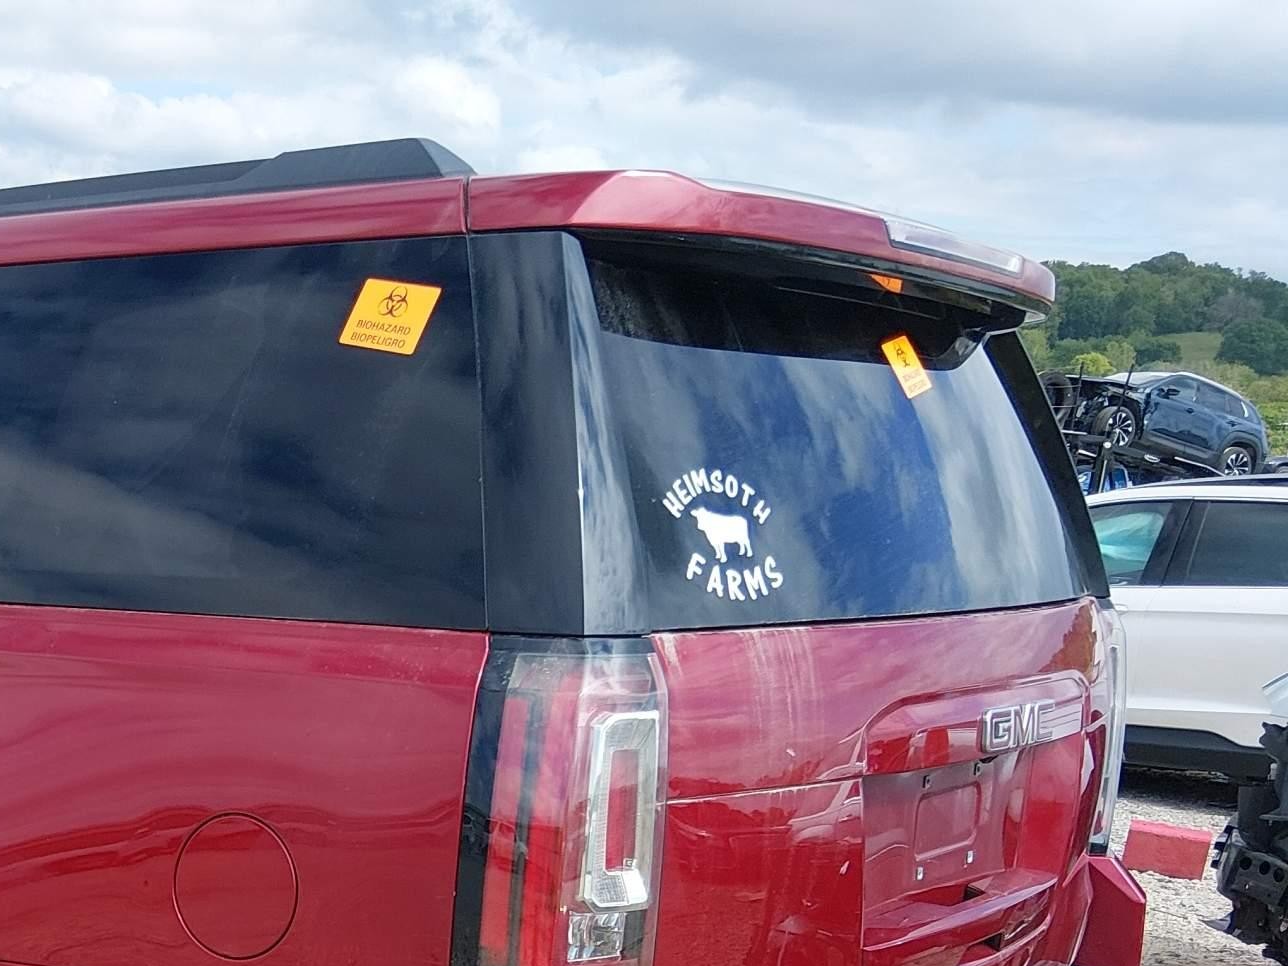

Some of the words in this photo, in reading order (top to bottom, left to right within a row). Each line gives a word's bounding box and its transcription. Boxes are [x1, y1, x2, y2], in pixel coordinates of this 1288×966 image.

[350, 331, 406, 349] BIOPELIGRO
[356, 319, 411, 336] BIOHAZARD
[662, 468, 771, 525] HEIMSOTH
[686, 552, 784, 601] FARMS
[983, 699, 1057, 753] GMC
